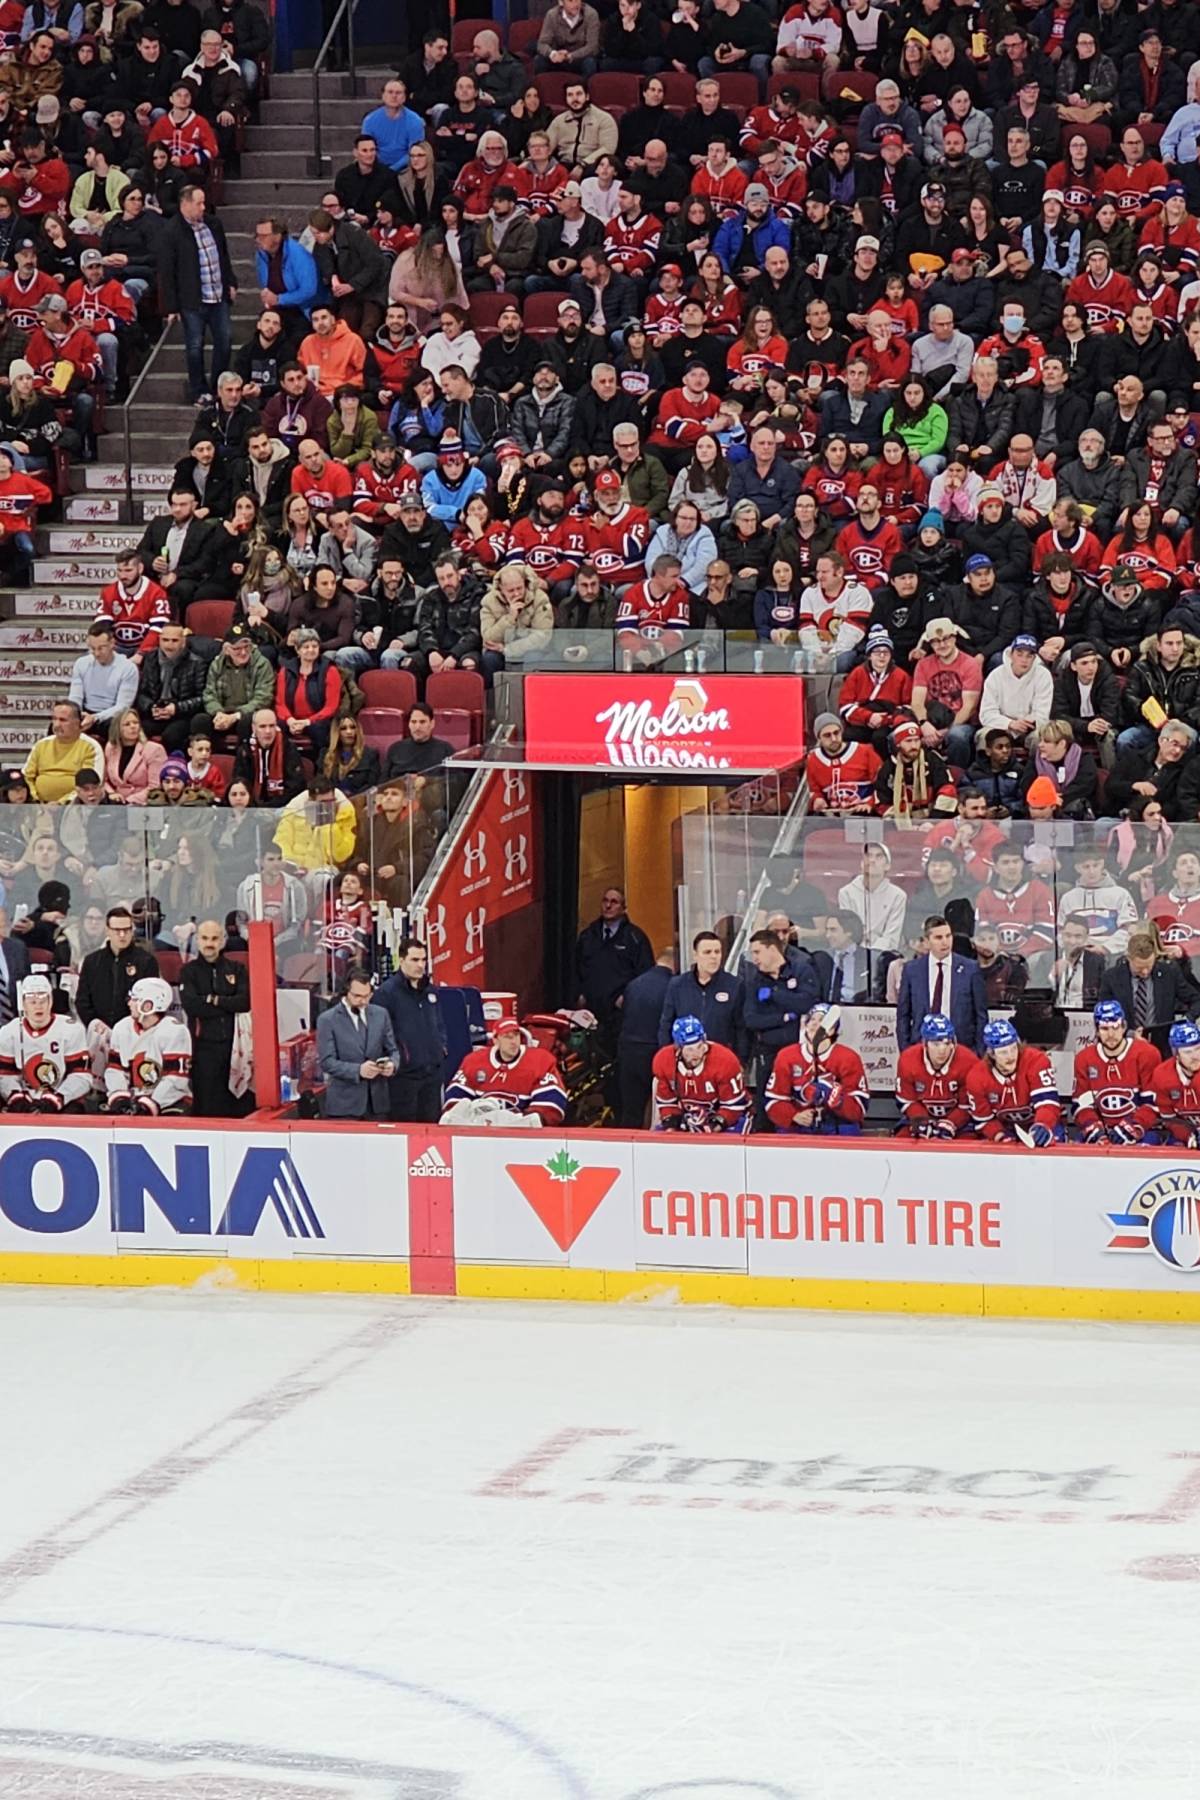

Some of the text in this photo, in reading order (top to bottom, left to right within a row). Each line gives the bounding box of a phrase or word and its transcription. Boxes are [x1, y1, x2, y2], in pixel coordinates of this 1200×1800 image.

[137, 474, 175, 484] EXPOR
[595, 700, 731, 744] Molson
[50, 1041, 60, 1053] C
[704, 1080, 715, 1093] A
[949, 1080, 959, 1091] C
[409, 1163, 452, 1178] adidas
[642, 1188, 1001, 1248] CANADIAN TIRE
